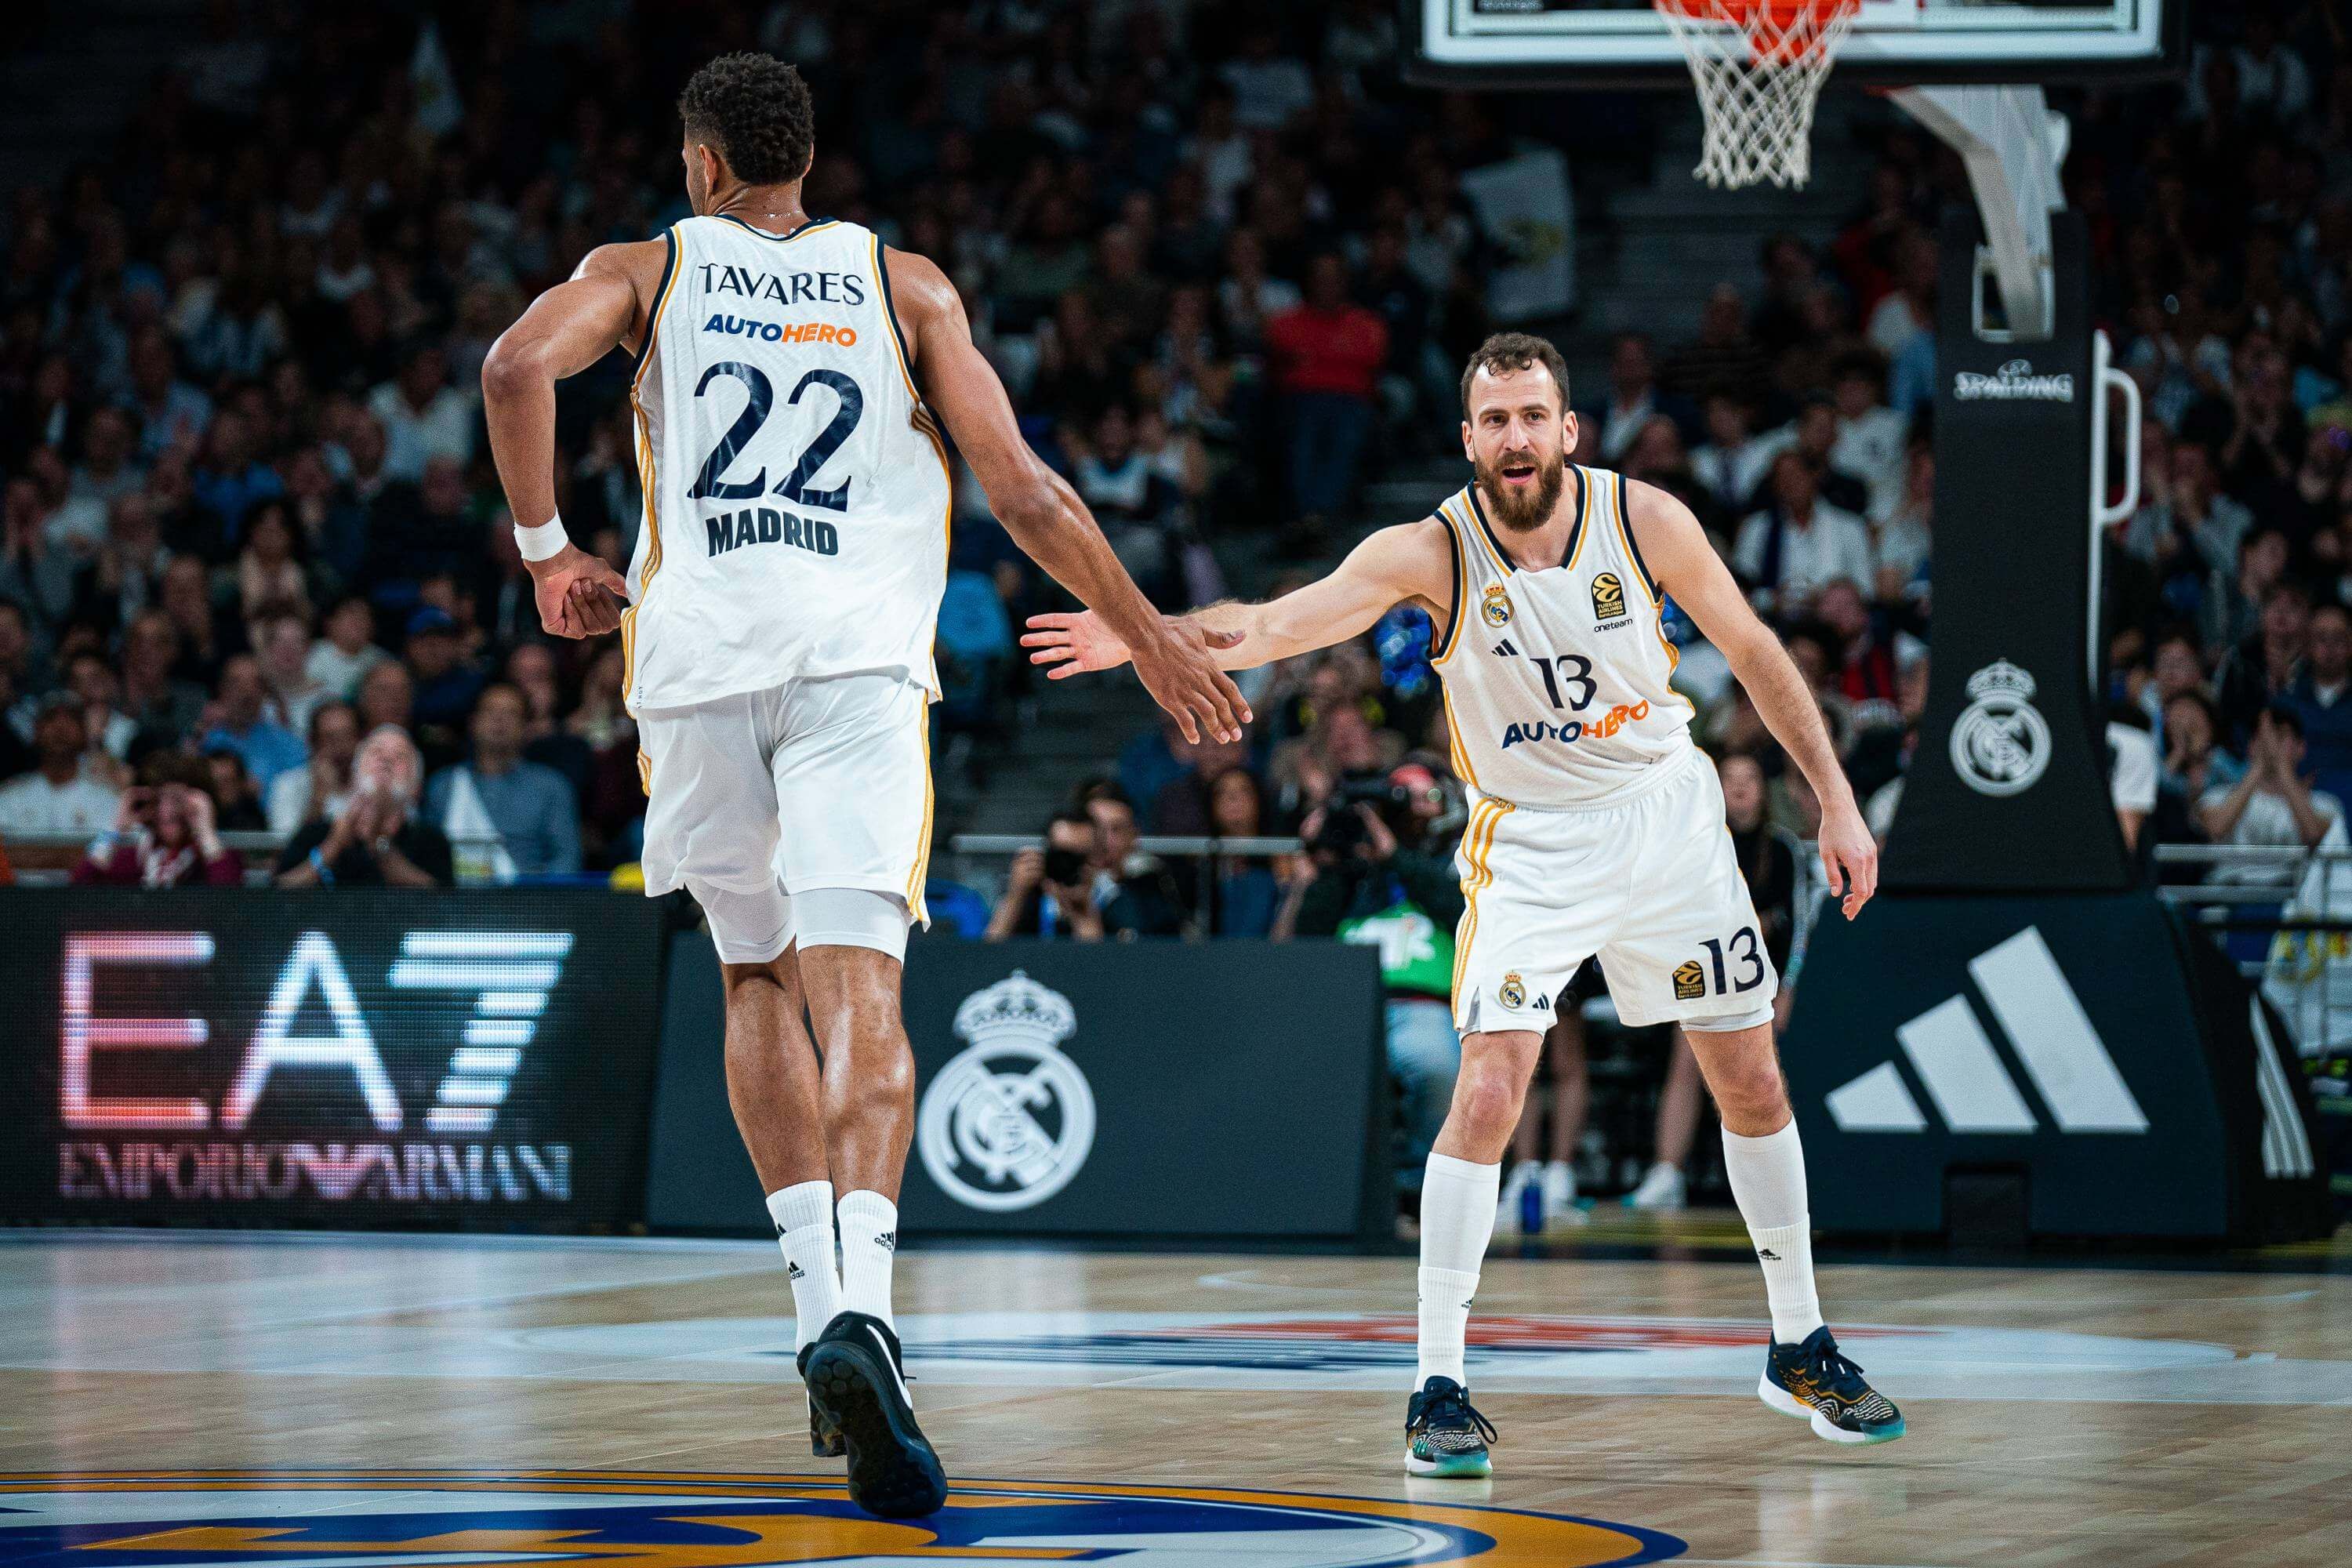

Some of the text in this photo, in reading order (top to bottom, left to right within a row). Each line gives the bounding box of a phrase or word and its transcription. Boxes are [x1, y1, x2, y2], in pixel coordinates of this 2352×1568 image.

[699, 263, 865, 306] TAVARES
[702, 314, 857, 347] AUTOHERO
[687, 361, 863, 512] 22
[706, 507, 839, 557] MADRID
[1594, 618, 1633, 633] oneteam
[1597, 600, 1623, 609] TURKISH
[1530, 654, 1598, 711] 13
[1501, 699, 1649, 750] AUTOHERO
[1699, 926, 1764, 995] 13
[60, 930, 574, 1132] EA7
